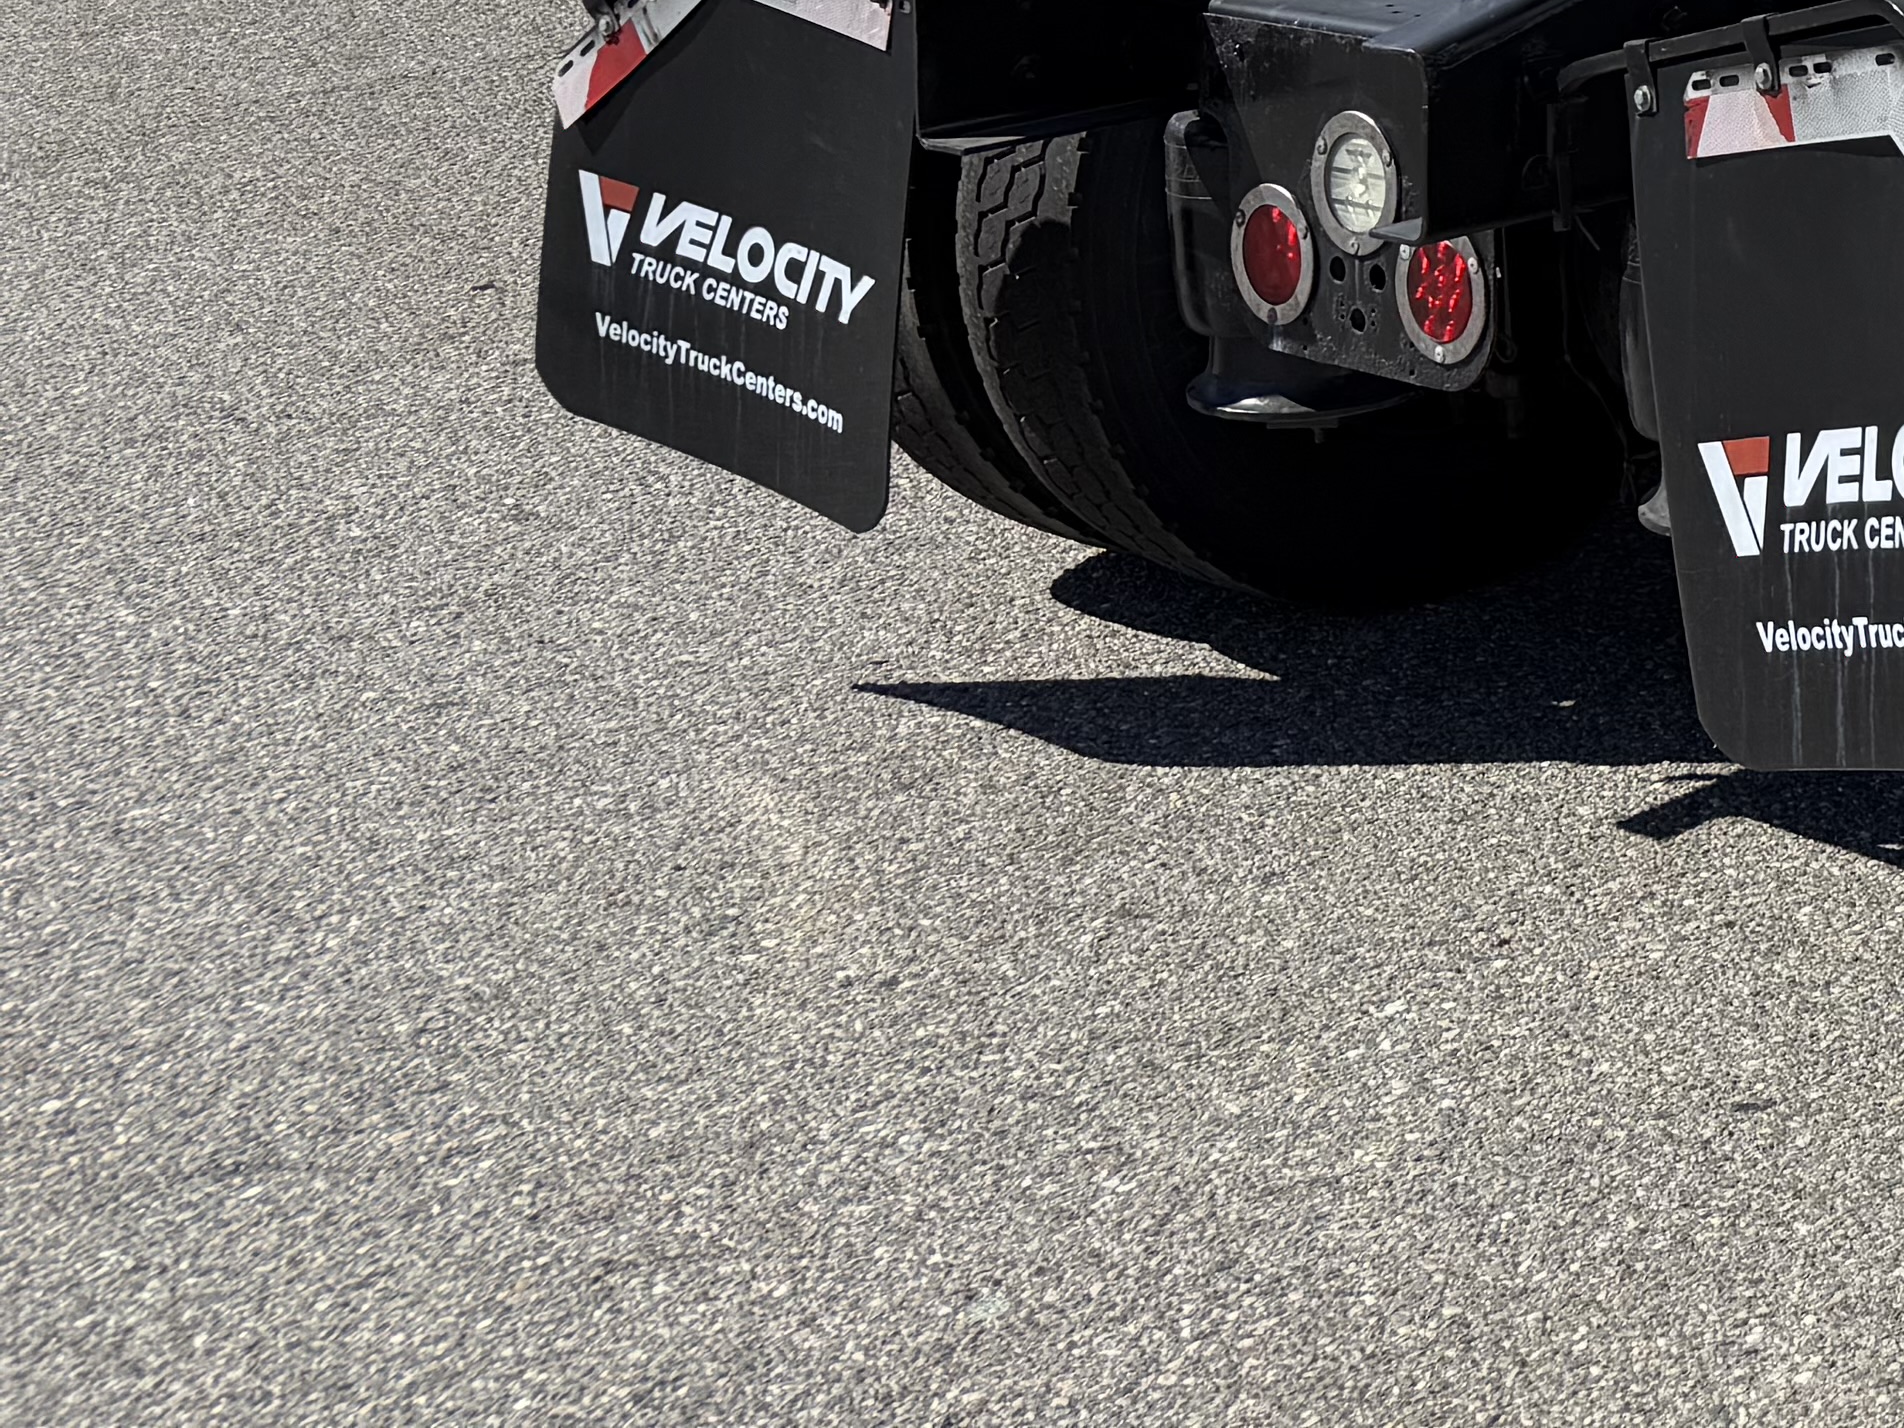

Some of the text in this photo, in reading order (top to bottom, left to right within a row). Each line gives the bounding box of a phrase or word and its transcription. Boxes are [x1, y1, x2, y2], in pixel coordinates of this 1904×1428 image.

[630, 252, 790, 331] TRUCK CENTERS
[640, 192, 876, 325] VELOCITY
[595, 312, 844, 434] VelocityTruckCenters.com
[1780, 518, 1859, 554] TRUCK
